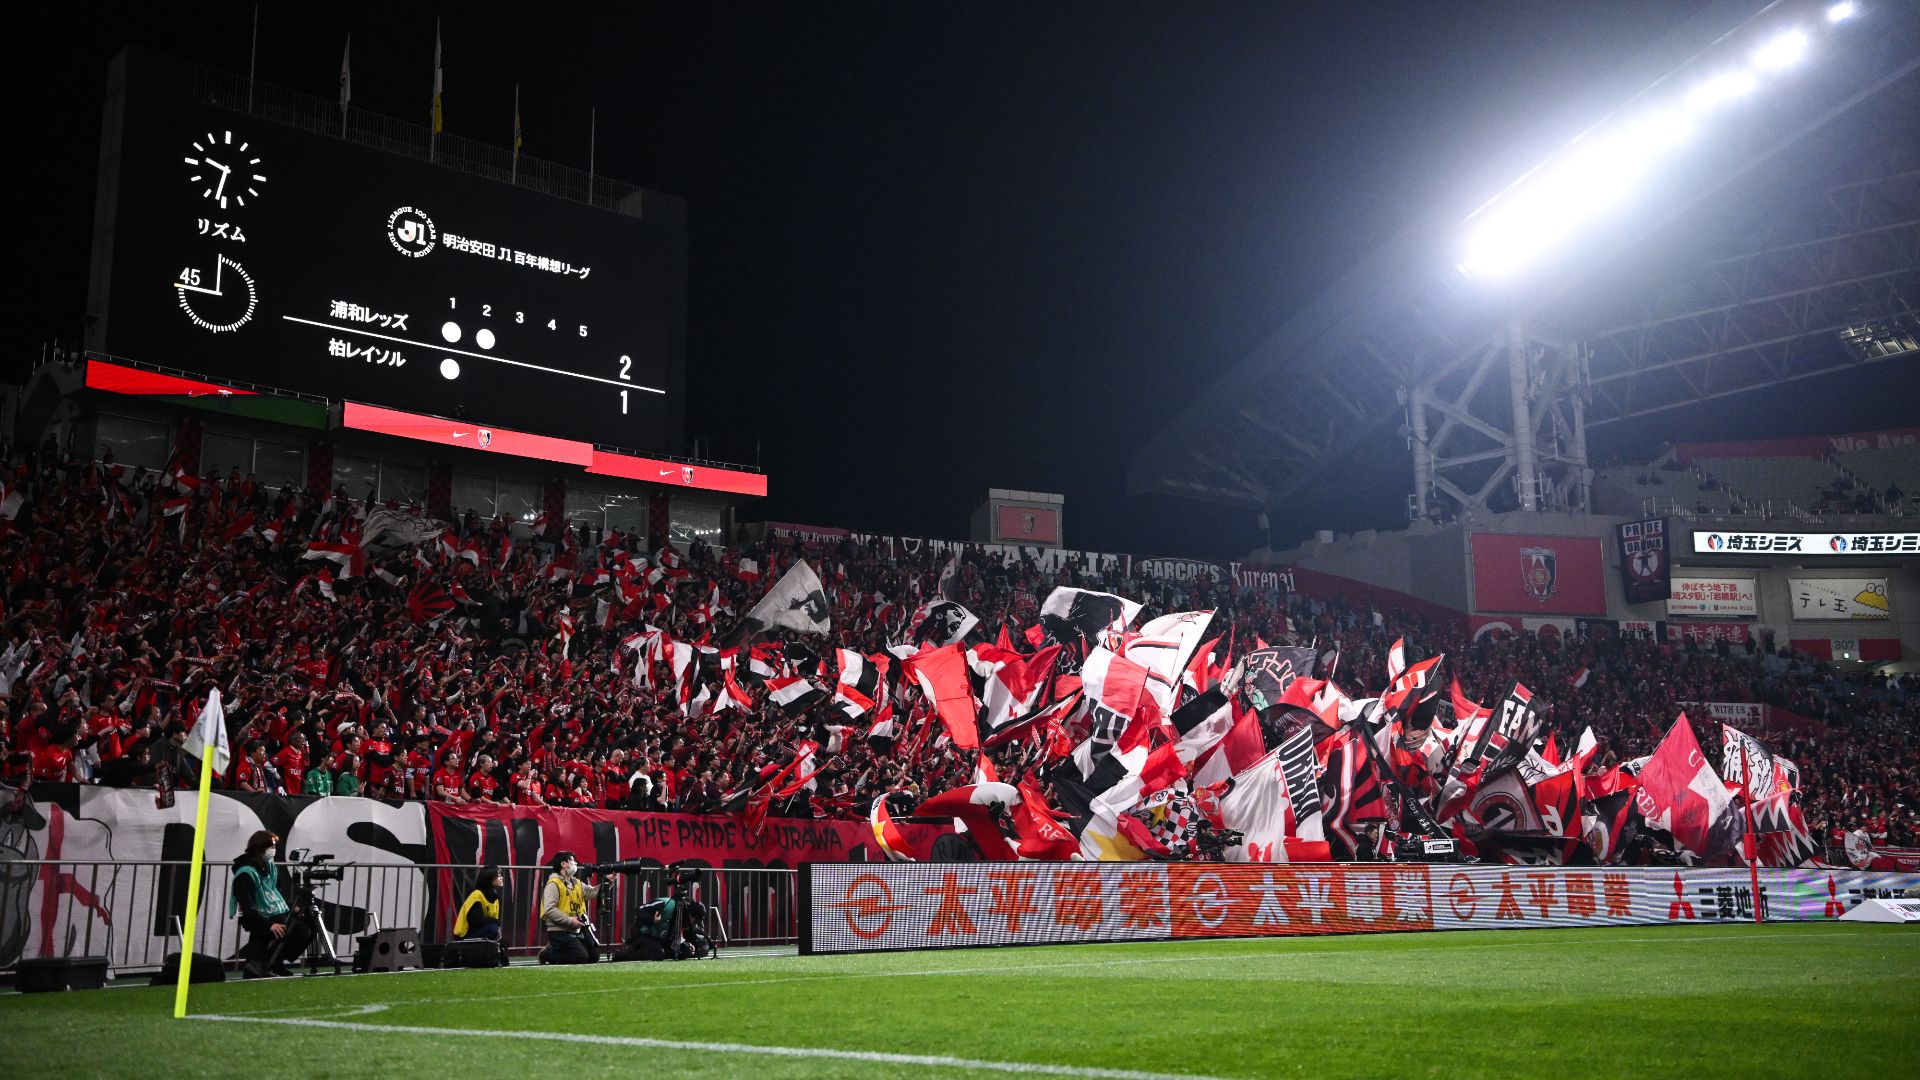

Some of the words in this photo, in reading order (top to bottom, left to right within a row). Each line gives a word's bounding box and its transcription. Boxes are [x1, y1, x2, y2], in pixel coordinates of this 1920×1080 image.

[198, 218, 246, 242] リズム
[443, 233, 496, 258] 明治安田
[498, 247, 512, 262] J1
[514, 250, 591, 279] 百年構想リーグ
[179, 267, 201, 286] 45
[330, 299, 409, 331] 浦和レッズ
[450, 297, 456, 309] 1
[482, 304, 492, 317] 2
[515, 312, 525, 324] 3
[547, 319, 557, 331] 4
[579, 326, 588, 337] 5
[328, 337, 407, 368] 柏レイソル
[619, 355, 632, 380] 2
[620, 390, 628, 414] 1
[1727, 535, 1803, 551] 埼玉シミズ
[1851, 536, 1920, 551] 埼玉シミ
[1799, 592, 1848, 613] テレ玉
[1834, 640, 1855, 650] 307
[1713, 705, 1734, 715] WITH
[1736, 705, 1746, 715] US
[627, 817, 671, 848] THE
[676, 819, 738, 850] PRIDE
[774, 825, 843, 850] URAWA
[1492, 872, 1633, 920] 太平電業
